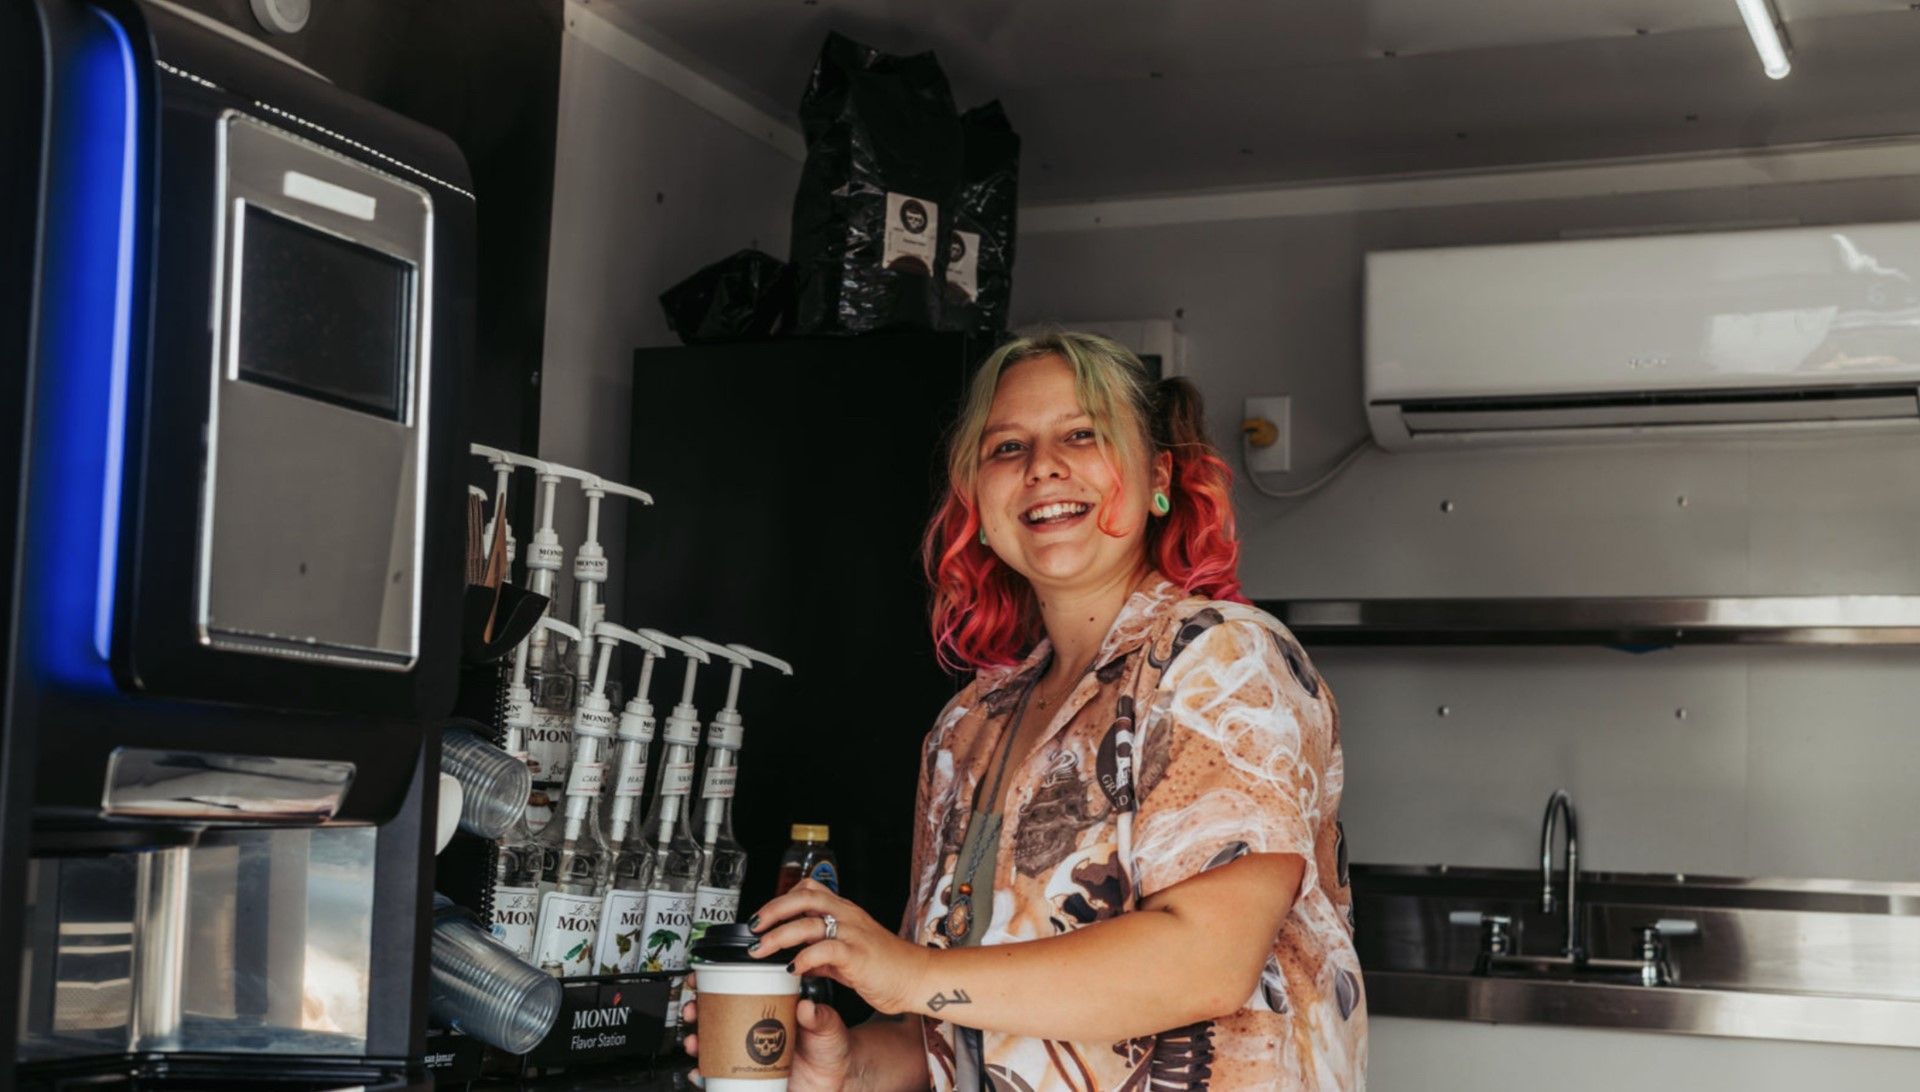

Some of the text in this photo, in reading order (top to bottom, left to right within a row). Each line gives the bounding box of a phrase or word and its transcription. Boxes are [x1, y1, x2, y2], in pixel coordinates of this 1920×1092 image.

[572, 1006, 630, 1030] MONIN
[571, 1032, 626, 1050] Flavor Station
